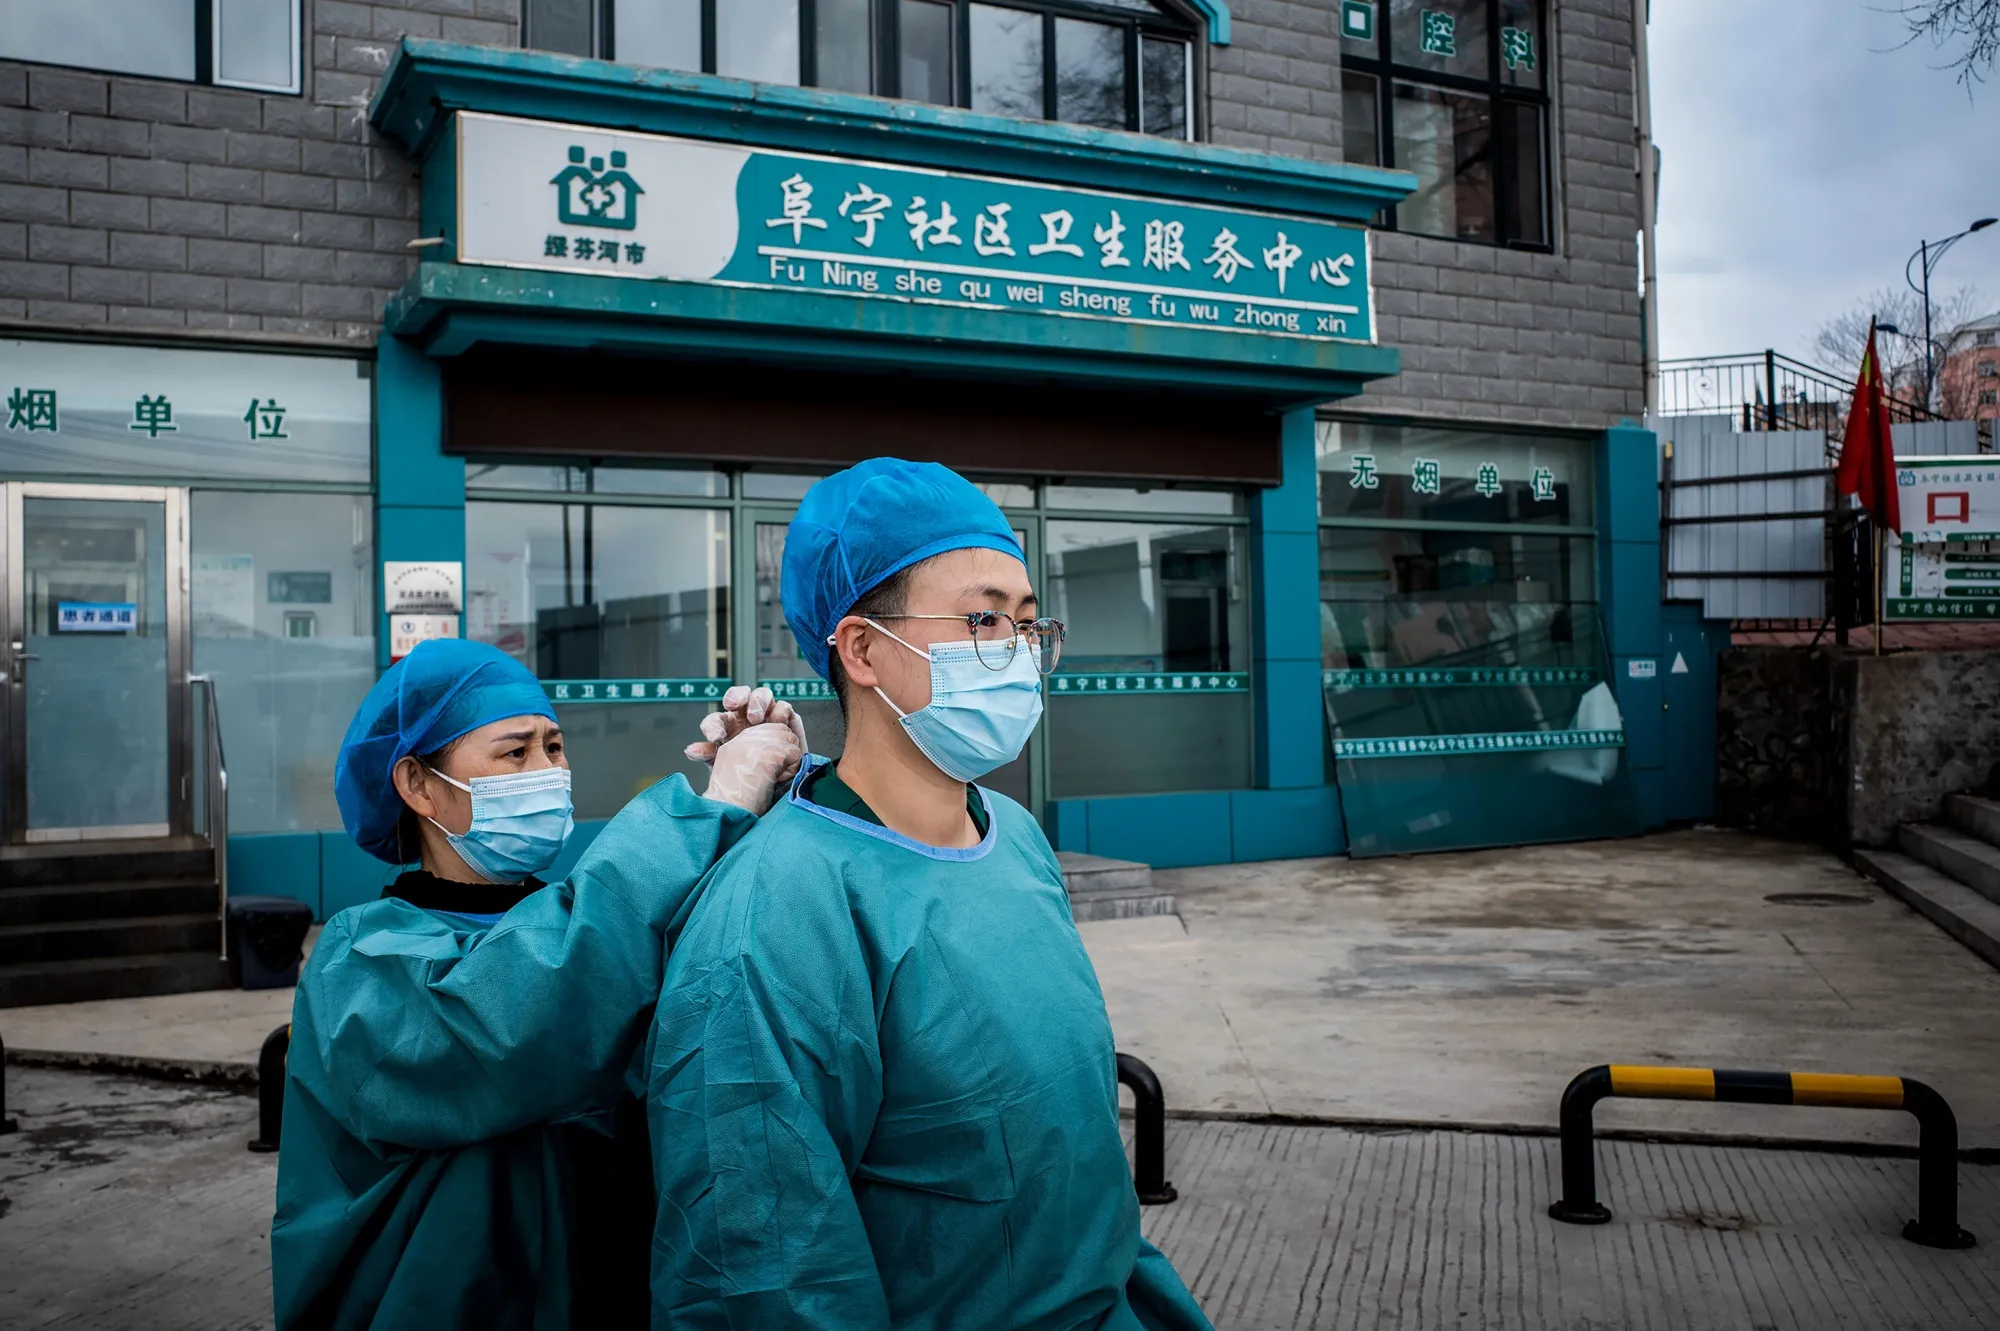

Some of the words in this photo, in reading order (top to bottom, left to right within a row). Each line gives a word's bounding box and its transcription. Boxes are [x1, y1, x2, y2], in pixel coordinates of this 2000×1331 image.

[1341, 0, 1536, 71] 口腔科
[765, 173, 1355, 294] 阜宁社区卫生服务中心
[770, 255, 806, 282] Fu
[822, 261, 878, 291] Ning
[895, 268, 942, 294] she
[960, 280, 991, 301] qu
[1006, 284, 1044, 304] wei
[1059, 286, 1132, 316] sheng
[1148, 295, 1176, 317] fu
[1189, 303, 1219, 321] wu
[1234, 308, 1300, 332] zhong
[1316, 315, 1347, 333] xin
[6, 386, 289, 440] 烟单位
[1350, 454, 1556, 499] 无烟单位
[555, 682, 719, 699] 区卫生服务中心
[1057, 676, 1239, 690] 阜宁社区卫生服务中心
